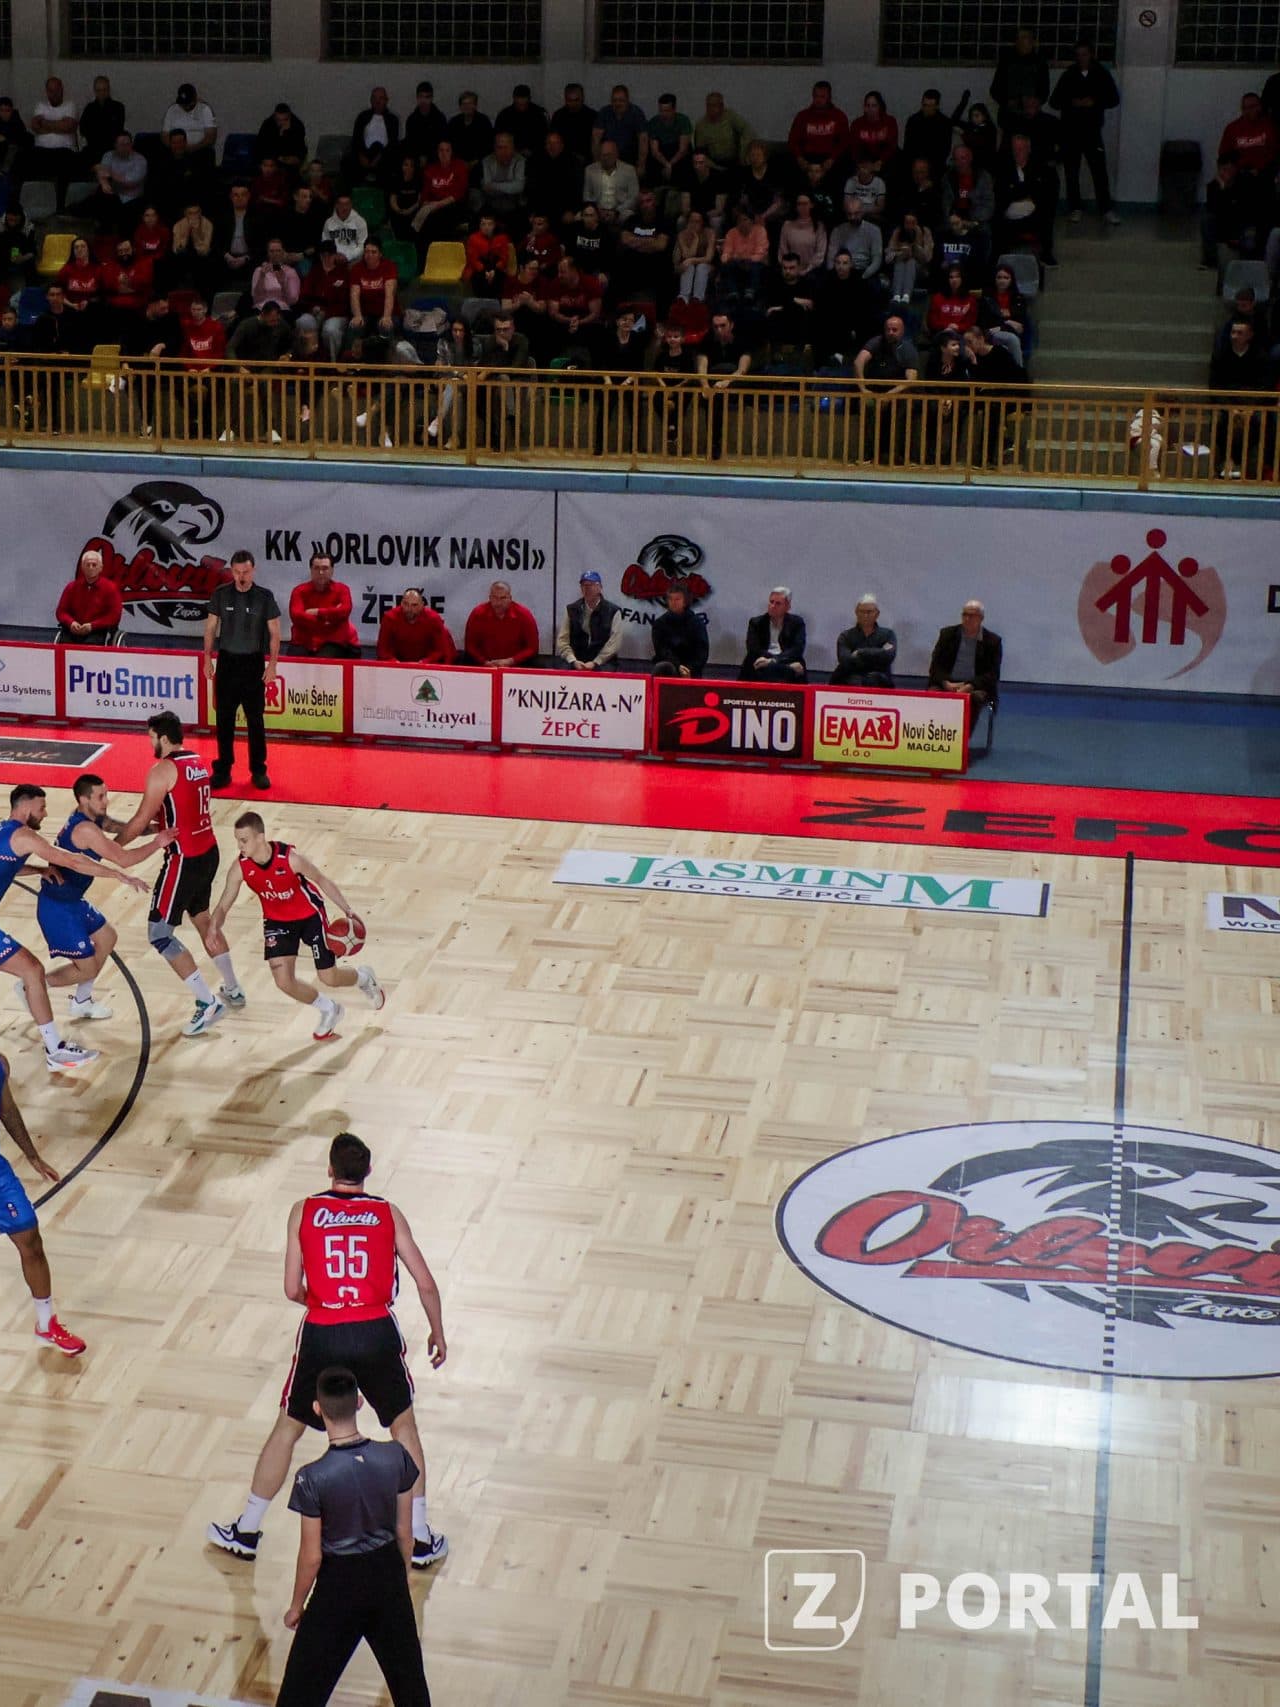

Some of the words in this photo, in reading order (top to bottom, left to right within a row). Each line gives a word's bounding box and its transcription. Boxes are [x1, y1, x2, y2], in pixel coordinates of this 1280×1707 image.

[265, 530, 301, 561] KK
[12, 685, 52, 696] Systems
[69, 664, 194, 700] ProSmart
[96, 698, 165, 710] SOLUTIONS
[287, 688, 309, 706] Novi
[311, 684, 338, 706] Šeher
[292, 707, 333, 718] MAGLAJ
[541, 716, 601, 739] ŽEPČE
[826, 714, 893, 742] EMAR
[902, 722, 925, 741] Novi
[927, 719, 958, 742] Šeher
[906, 743, 951, 753] MAGLAJ
[605, 856, 893, 889] JASMIN
[891, 874, 1005, 909] M
[653, 879, 751, 894] d.o.o.
[777, 887, 872, 902] ŽEPČE
[324, 1235, 368, 1279] 55
